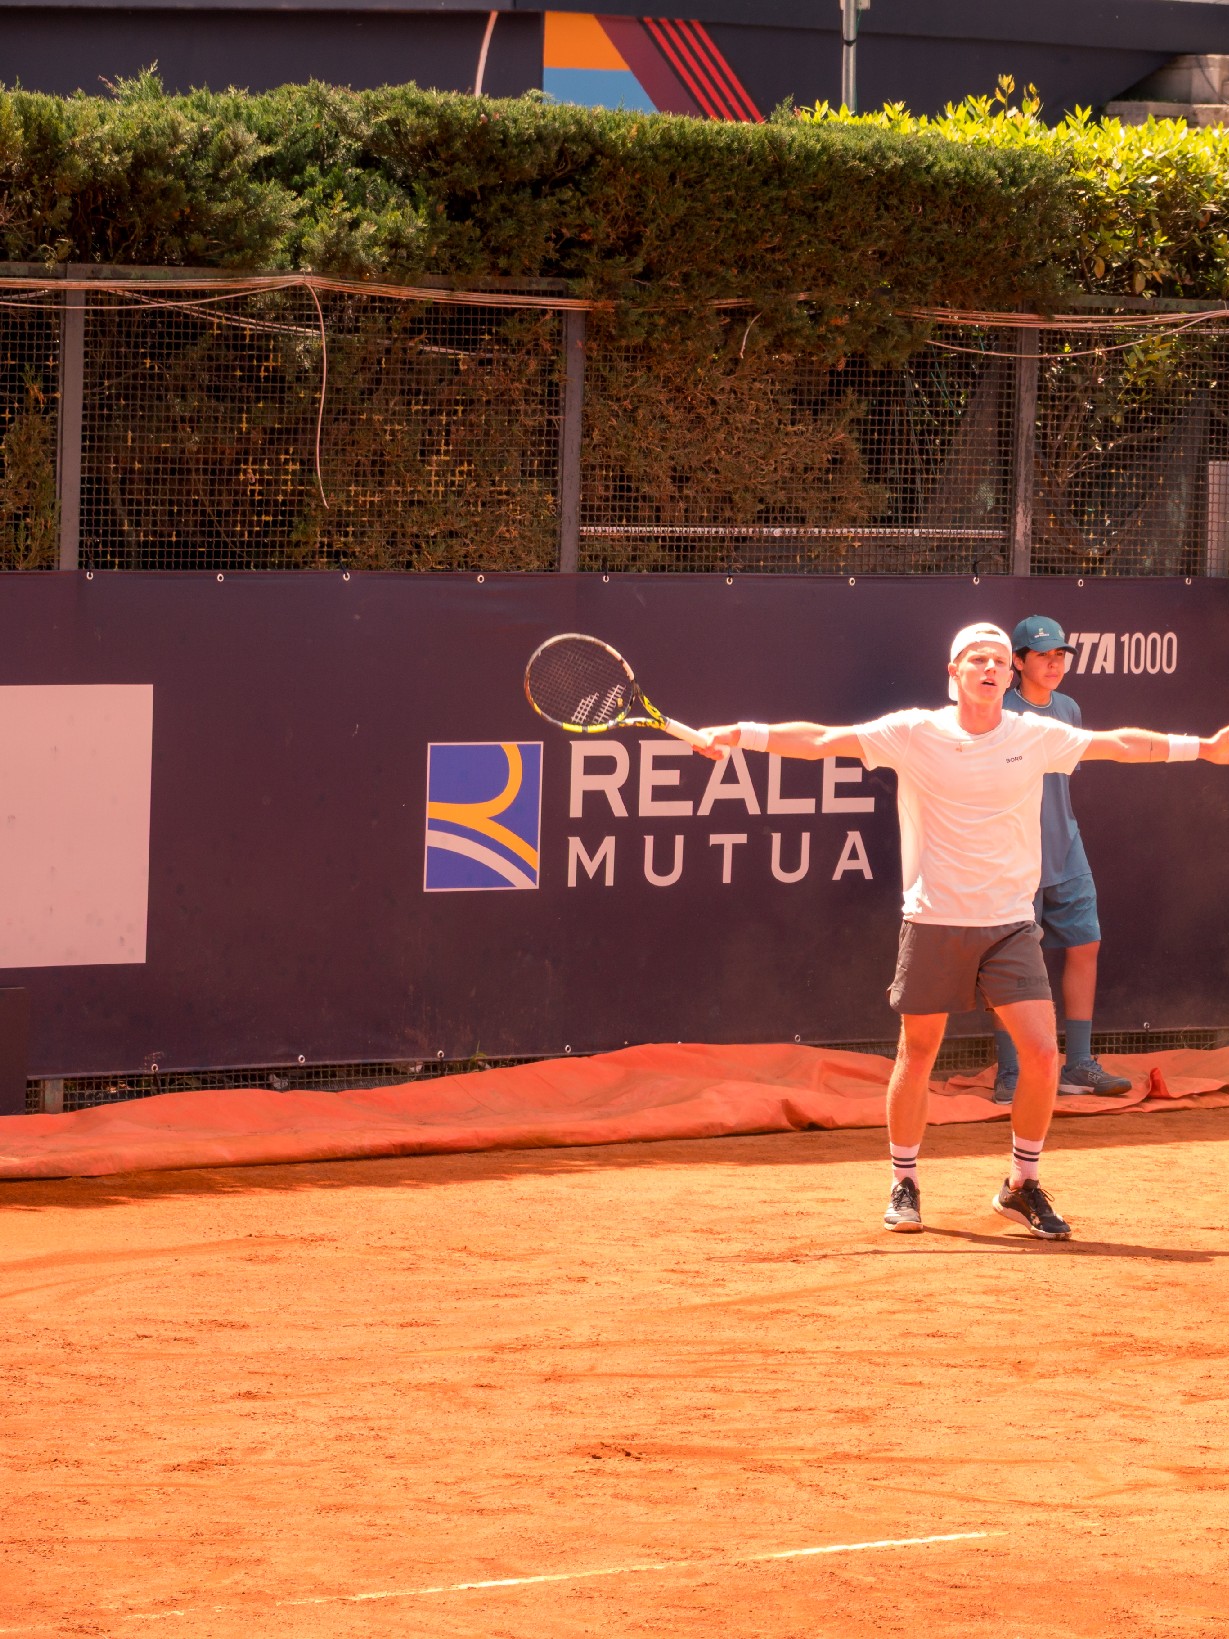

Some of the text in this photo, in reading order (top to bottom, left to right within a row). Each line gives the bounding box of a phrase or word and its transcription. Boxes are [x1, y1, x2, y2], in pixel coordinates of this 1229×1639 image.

[1121, 632, 1177, 674] 1000
[569, 740, 875, 818] REALE
[567, 831, 873, 888] MUTUA
